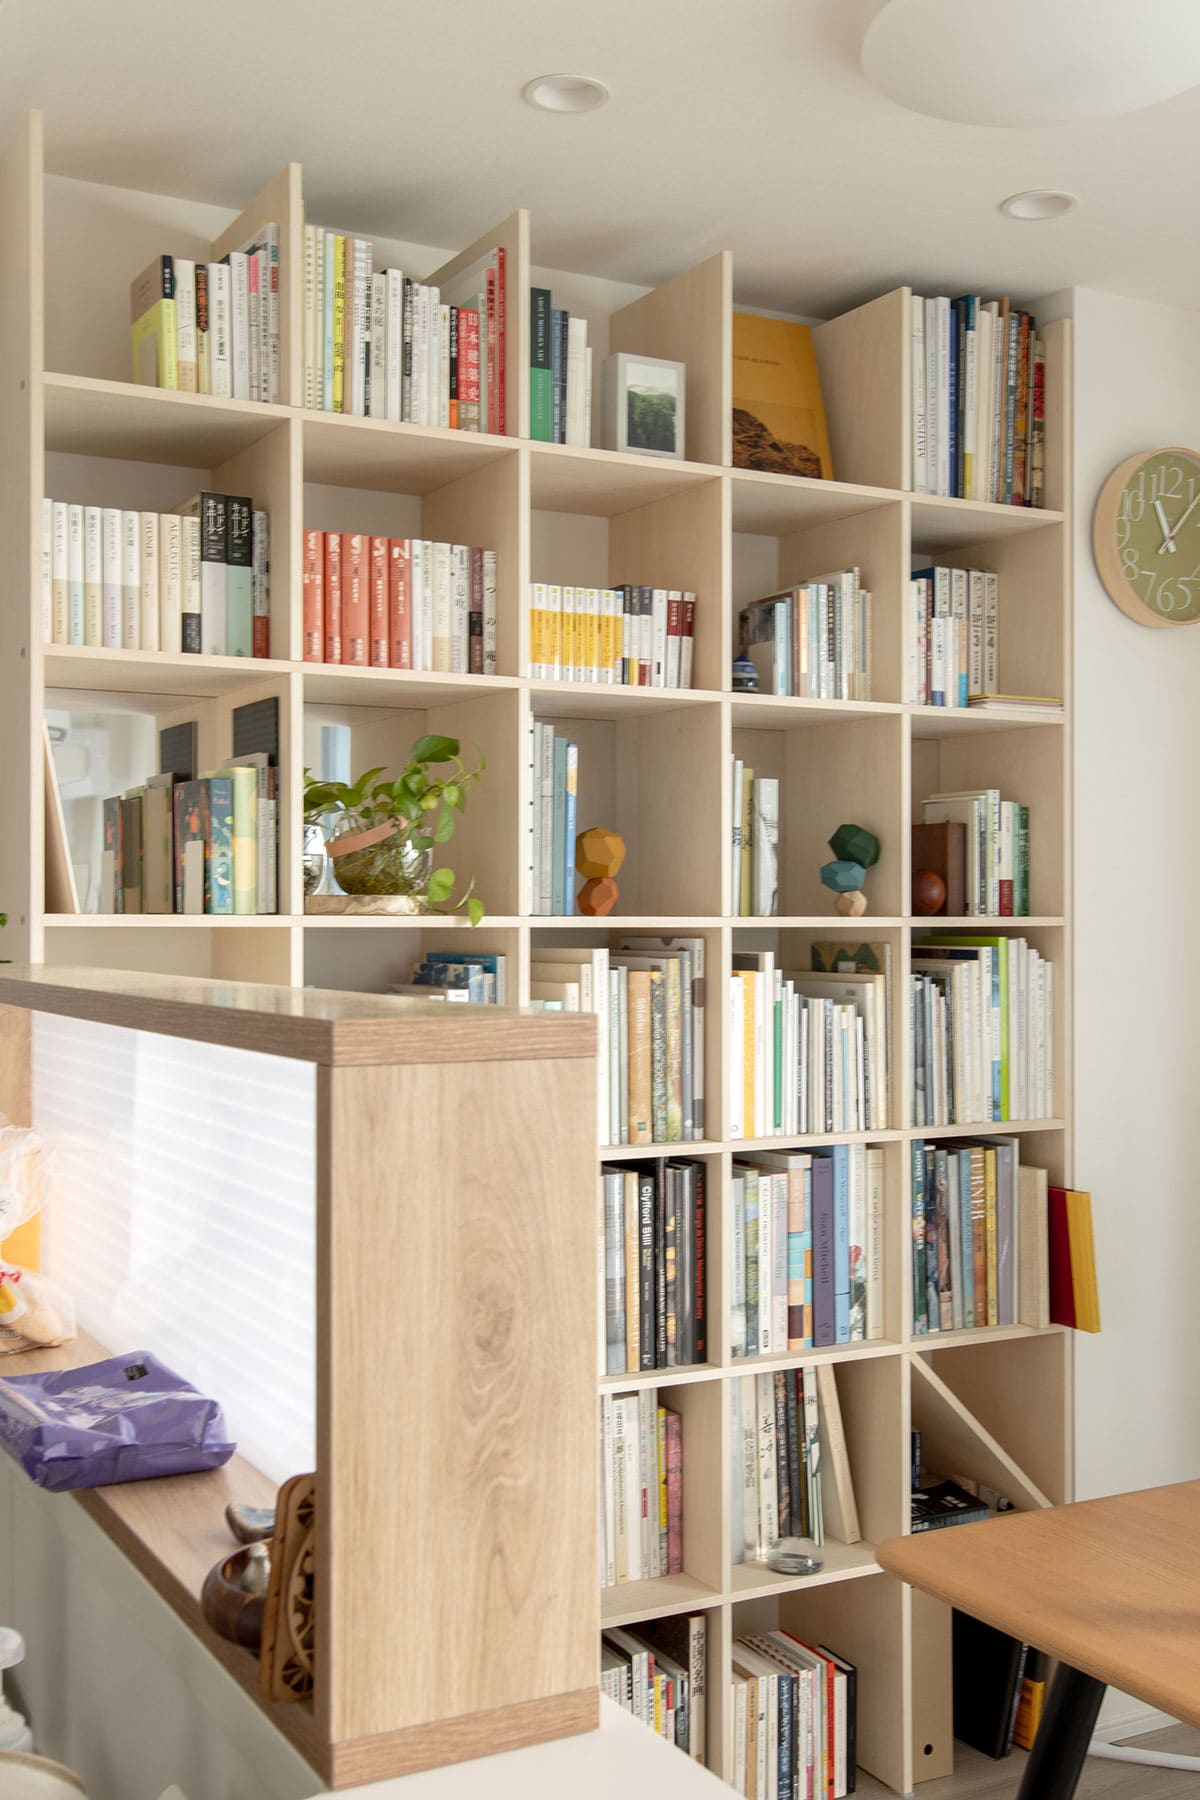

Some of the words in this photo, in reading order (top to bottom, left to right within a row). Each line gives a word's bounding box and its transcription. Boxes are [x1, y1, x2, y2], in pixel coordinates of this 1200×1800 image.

[1137, 471, 1158, 503] 11
[1159, 465, 1184, 498] 12
[1122, 489, 1145, 521] 10
[1122, 548, 1139, 580] 8
[1139, 570, 1157, 603] 7
[1156, 577, 1175, 612] 6
[1175, 577, 1193, 610] 5
[970, 1153, 985, 1221] TURNER
[640, 1185, 652, 1224] Clyfford
[641, 1226, 652, 1246] Still
[820, 1239, 829, 1284] Mitchell
[692, 1629, 704, 1698] 中国の名画
